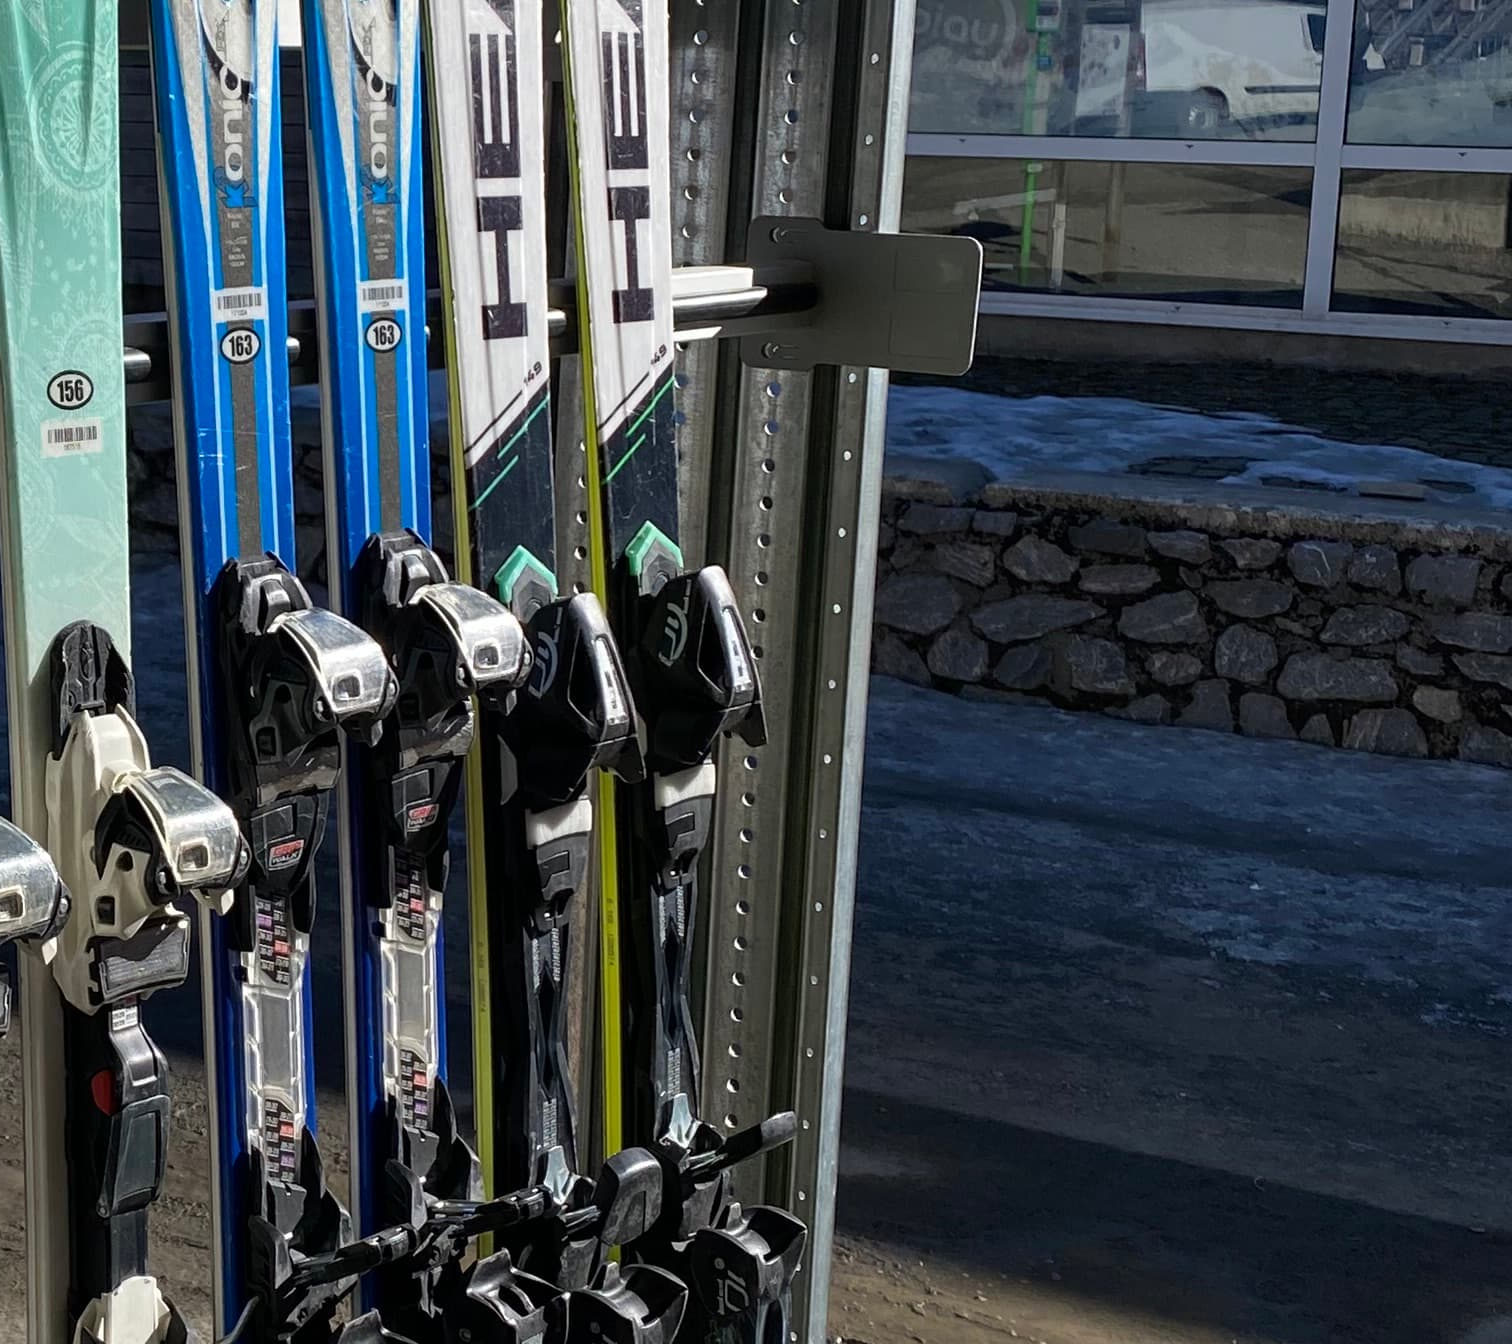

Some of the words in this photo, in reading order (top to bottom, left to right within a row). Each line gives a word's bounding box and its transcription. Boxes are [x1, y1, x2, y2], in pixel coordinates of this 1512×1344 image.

[228, 334, 253, 357] 163
[373, 324, 395, 346] 163
[57, 379, 85, 403] 156
